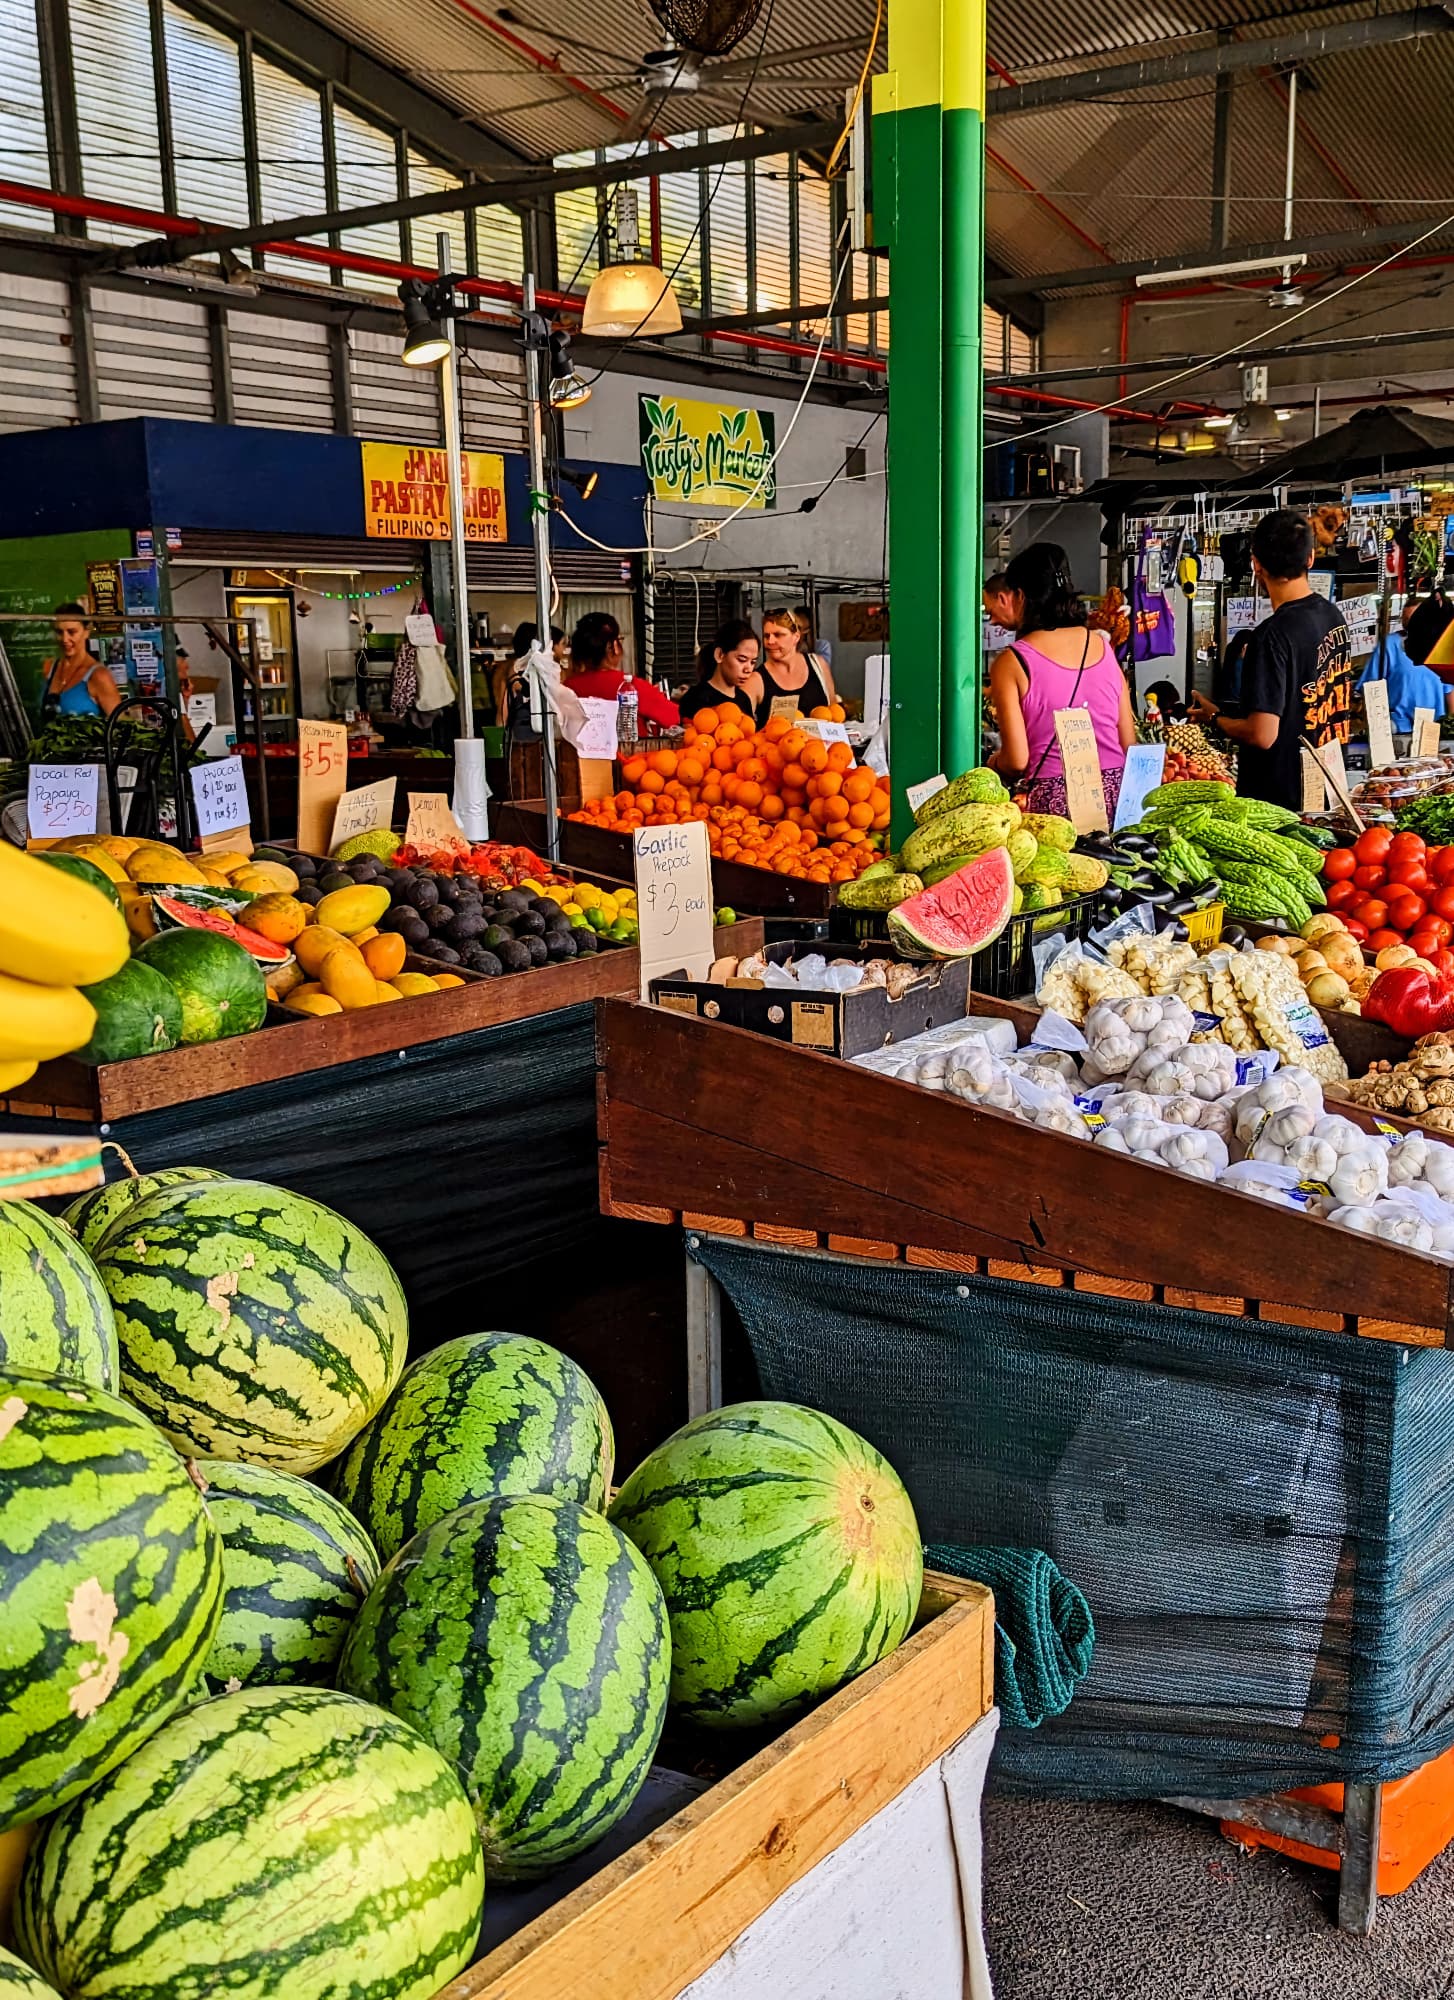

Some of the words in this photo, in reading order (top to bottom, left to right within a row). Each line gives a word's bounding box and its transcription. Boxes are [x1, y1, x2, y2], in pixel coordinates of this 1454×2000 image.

[371, 480, 447, 519] PASTRY
[463, 486, 501, 519] HOP
[377, 519, 434, 537] FILIPINO
[440, 522, 499, 538] DIGHTS
[1338, 597, 1368, 611] HOKO
[1317, 624, 1351, 669] ANTI
[1301, 649, 1351, 703] SOCIA
[74, 767, 92, 779] Red
[303, 742, 333, 777] $5
[35, 785, 80, 804] Papaya
[43, 800, 93, 827] $2.50
[637, 830, 688, 857] Garlic
